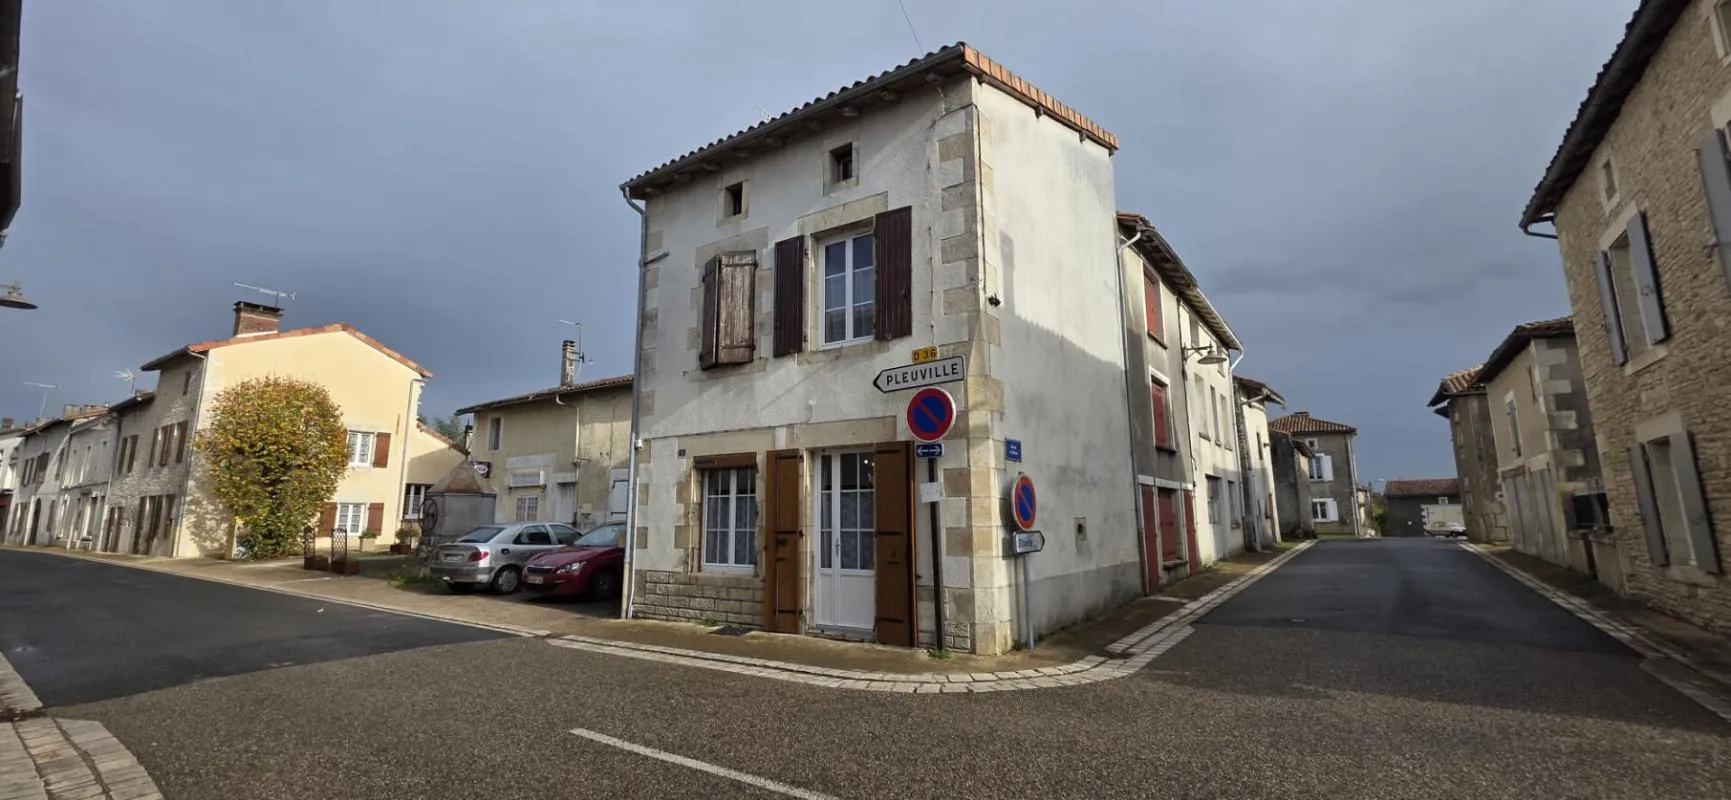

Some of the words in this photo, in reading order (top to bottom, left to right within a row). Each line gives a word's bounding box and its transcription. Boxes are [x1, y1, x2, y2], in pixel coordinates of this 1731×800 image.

[913, 352, 920, 361] D
[923, 349, 937, 359] 36
[886, 363, 959, 386] PLEUVILLE
